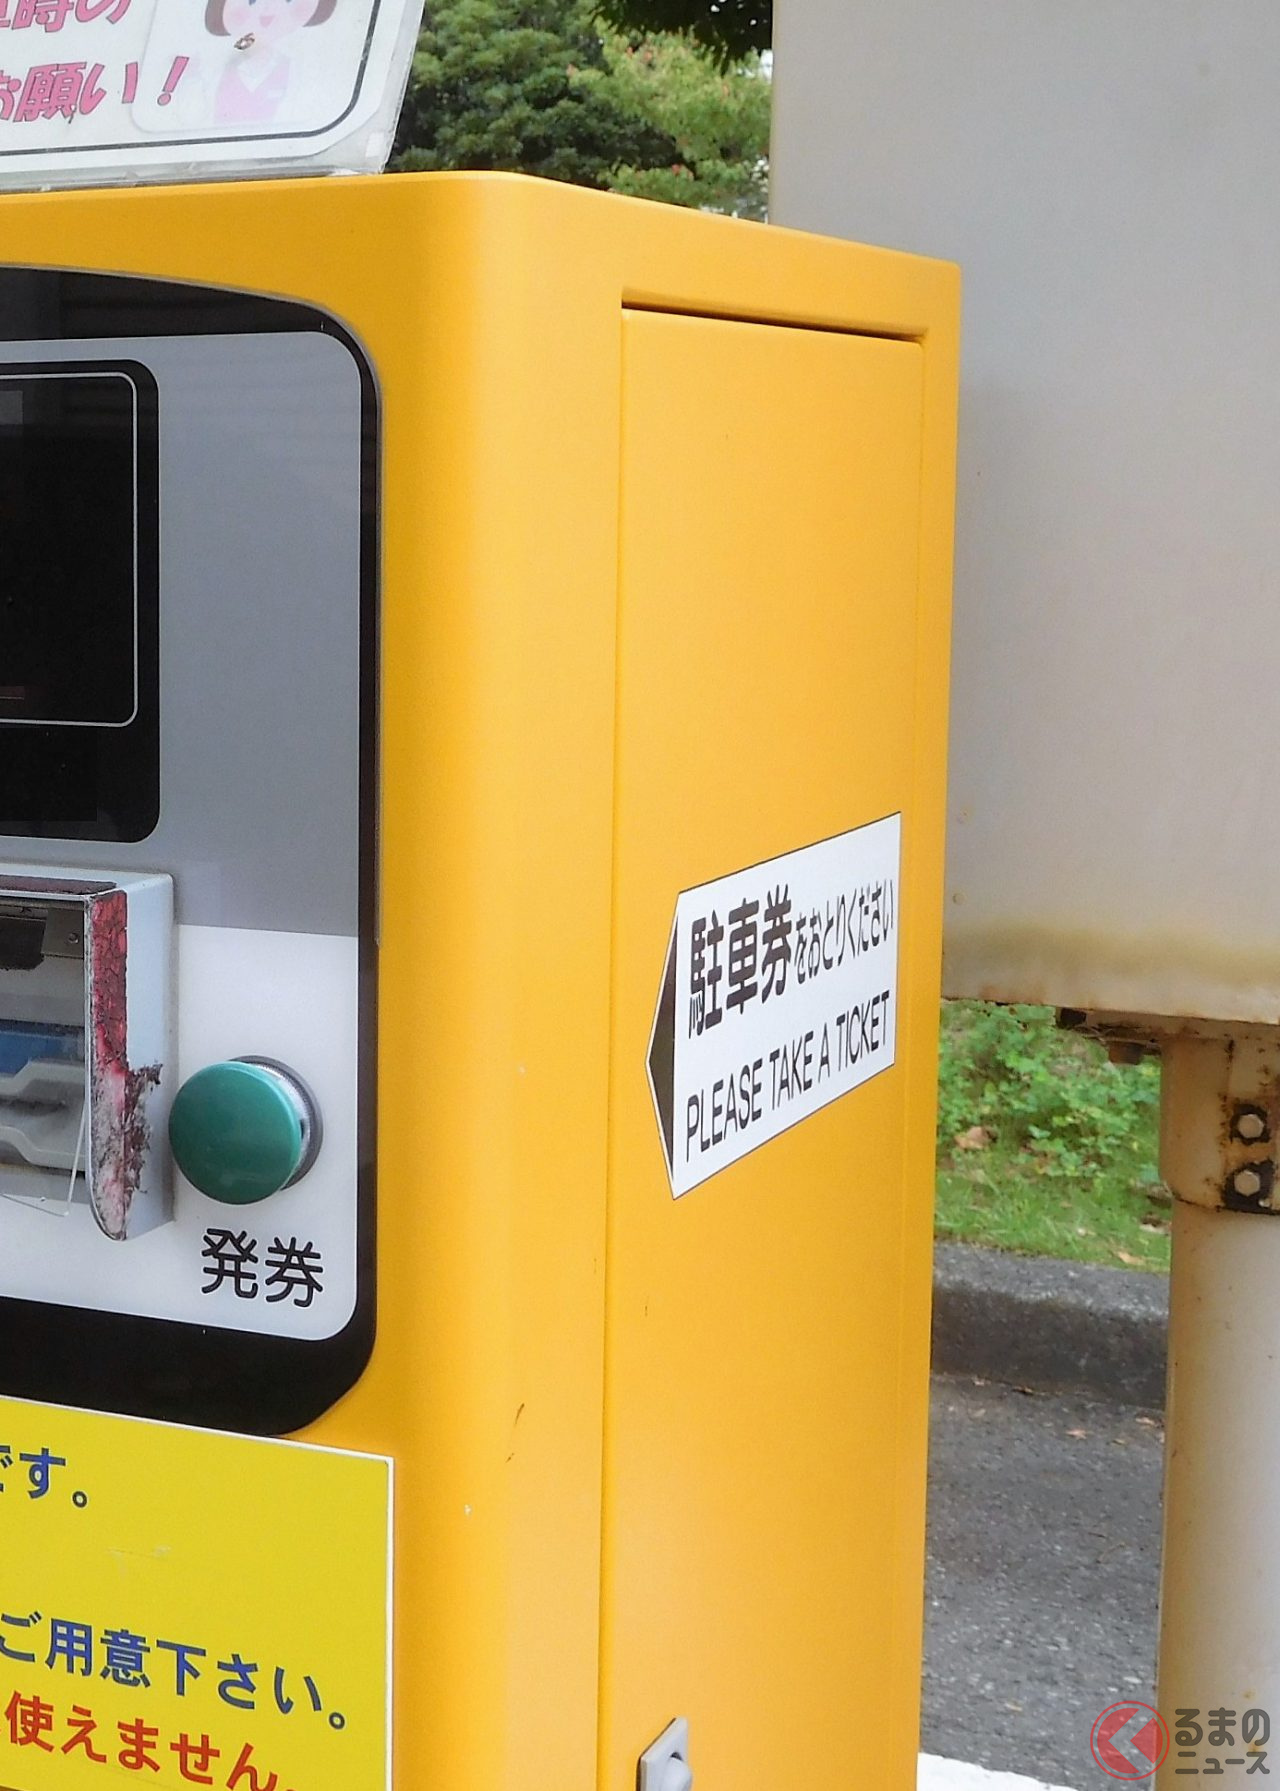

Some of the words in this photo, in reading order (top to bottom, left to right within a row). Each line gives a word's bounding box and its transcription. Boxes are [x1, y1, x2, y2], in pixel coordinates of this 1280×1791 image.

[688, 879, 895, 1040] 駐車券をおとりください
[686, 1058, 762, 1163] PLEASE
[769, 1031, 814, 1112] TAKE
[817, 1022, 831, 1084] A
[836, 989, 890, 1070] TICKET
[201, 1227, 324, 1308] 発券
